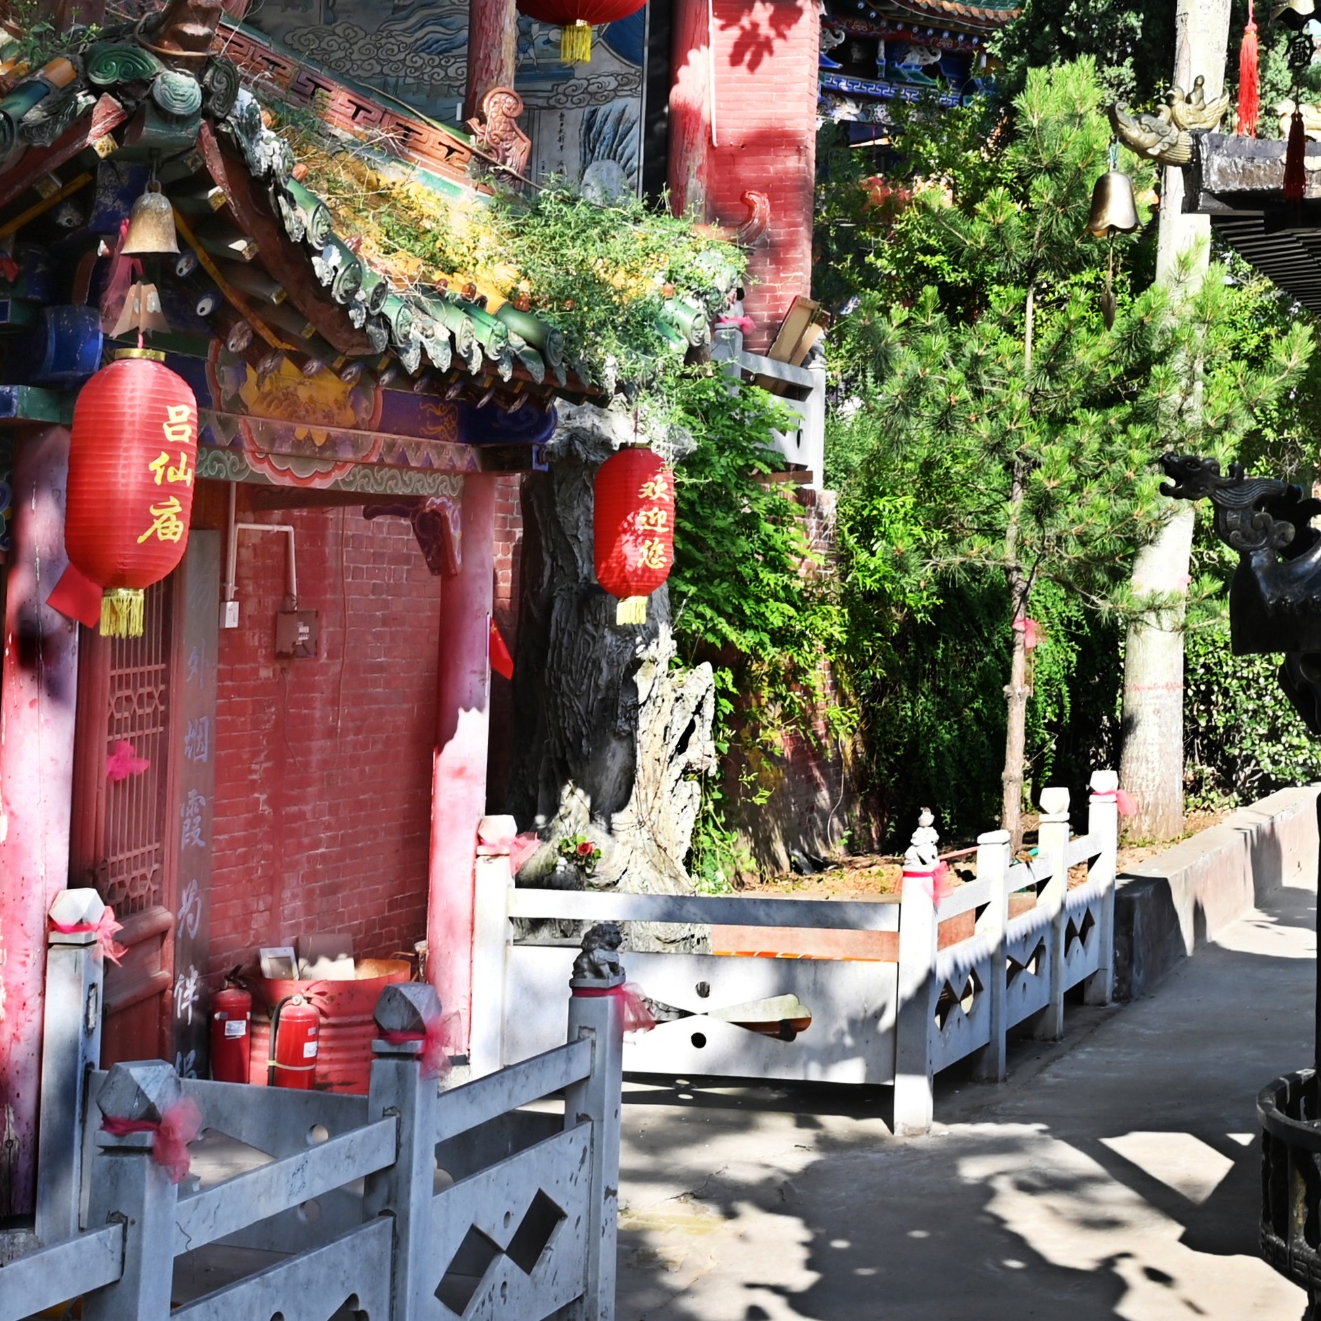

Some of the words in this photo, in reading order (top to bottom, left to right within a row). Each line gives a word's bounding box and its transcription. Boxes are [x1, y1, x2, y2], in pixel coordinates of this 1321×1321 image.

[136, 404, 194, 544] 吕仙庙
[636, 474, 671, 570] 欢迎您
